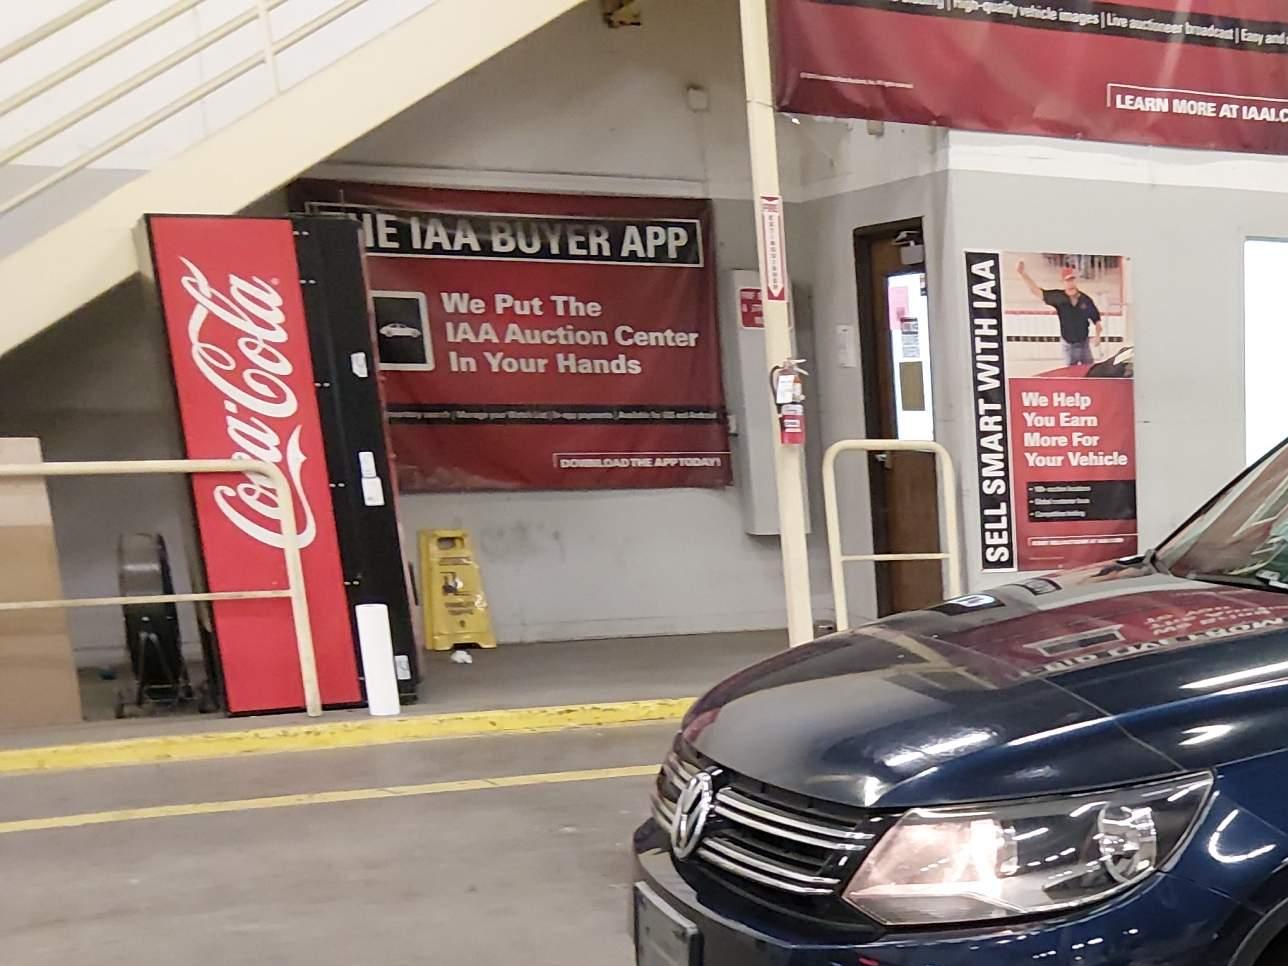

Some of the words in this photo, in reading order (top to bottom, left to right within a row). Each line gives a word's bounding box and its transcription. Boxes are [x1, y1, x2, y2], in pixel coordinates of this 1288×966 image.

[1059, 8, 1099, 25] images
[1107, 12, 1128, 28] Live
[1129, 18, 1183, 34] auctioneer
[1184, 22, 1234, 40] broadcast
[1241, 29, 1264, 45] Easy
[1265, 32, 1285, 45] and
[1115, 94, 1169, 113] LEARN
[1172, 99, 1217, 117] MORE
[1219, 103, 1238, 119] AT
[410, 216, 481, 253] IAA
[491, 220, 612, 258] BUYER
[620, 225, 689, 259] APP
[970, 258, 996, 309] IAA
[440, 292, 486, 315] We
[494, 293, 544, 316] Put
[551, 295, 603, 317] The
[446, 322, 499, 344] IAA
[504, 323, 608, 346] Auction
[614, 326, 699, 348] Center
[449, 353, 477, 372] In
[483, 353, 548, 373] Your
[556, 354, 643, 375] Hands
[974, 317, 1001, 392] WITH
[1021, 391, 1048, 408] We
[1052, 391, 1092, 410] Help
[1023, 412, 1055, 428] You
[1059, 412, 1098, 427] Earn
[978, 398, 1007, 496] SMART
[1023, 432, 1068, 448] More
[1072, 432, 1100, 447] For
[631, 458, 653, 468] THE
[654, 457, 679, 467] APP
[1024, 452, 1064, 468] Your
[1067, 450, 1129, 467] Vehicle
[982, 502, 1010, 563] SELL
